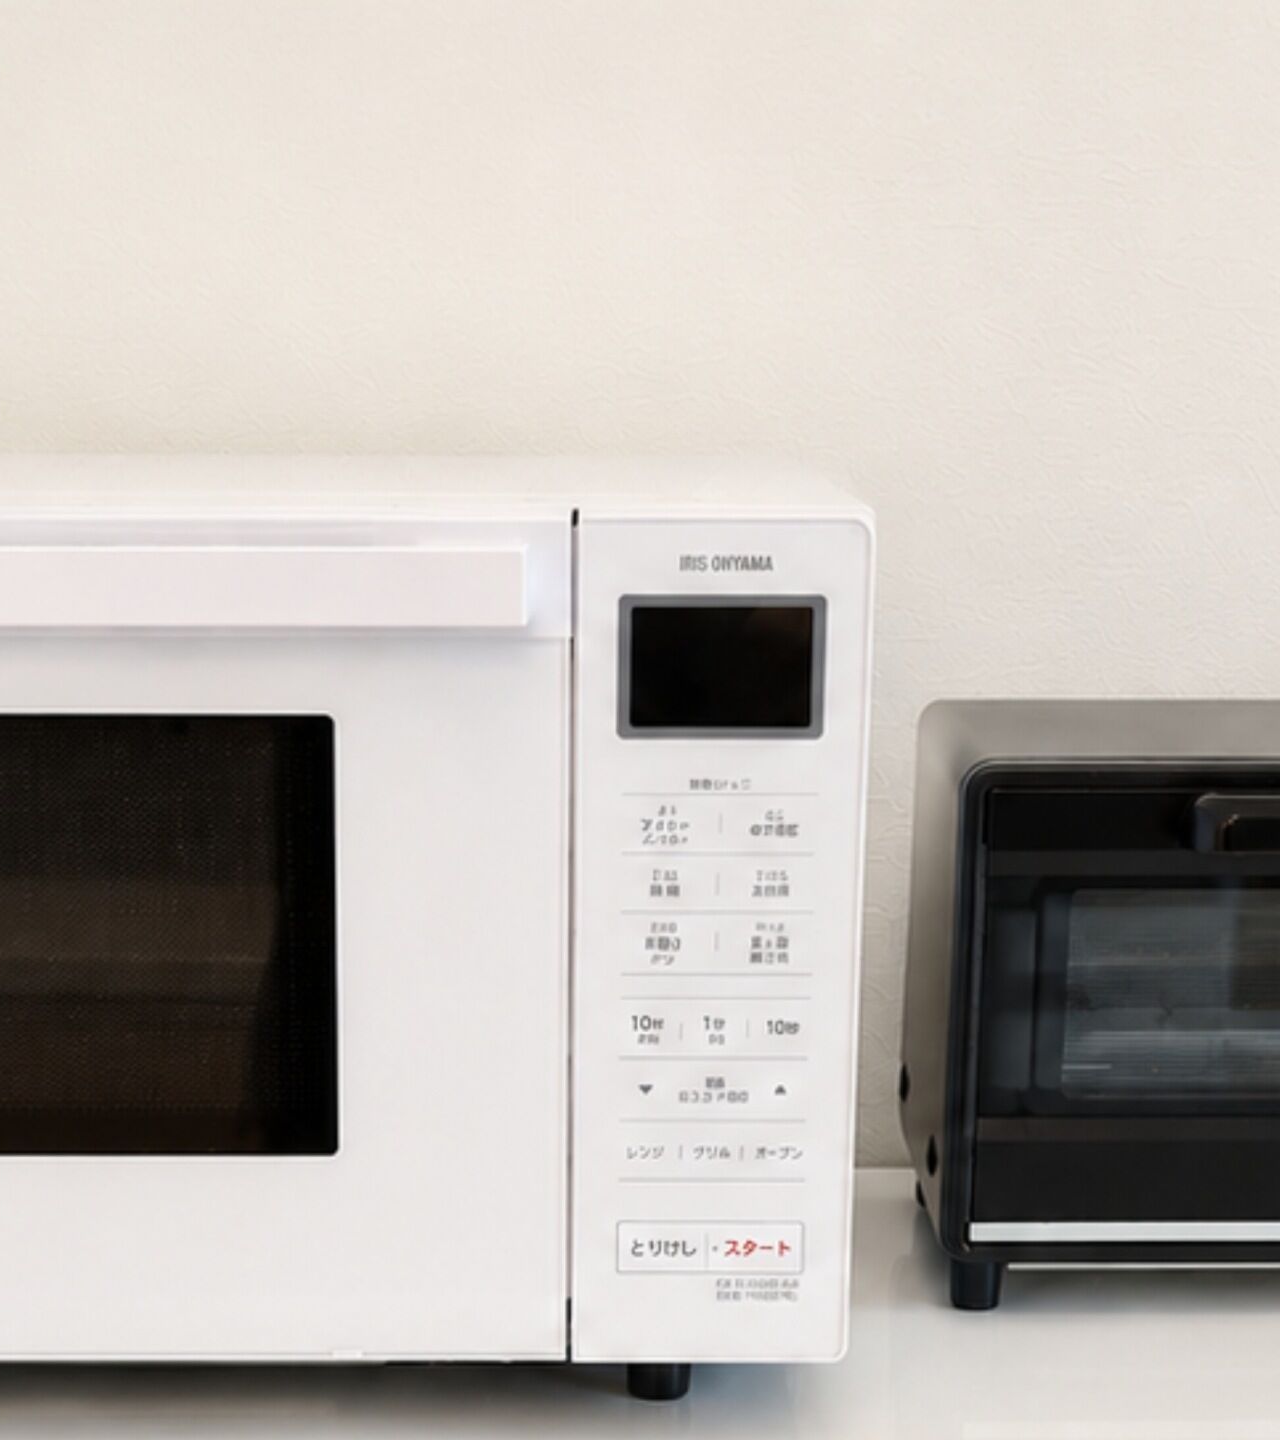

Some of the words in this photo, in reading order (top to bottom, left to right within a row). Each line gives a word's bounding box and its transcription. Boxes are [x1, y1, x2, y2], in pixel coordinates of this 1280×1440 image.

[680, 555, 708, 571] IRIS
[711, 555, 774, 571] OHYAMA
[724, 1239, 791, 1257] スタート
